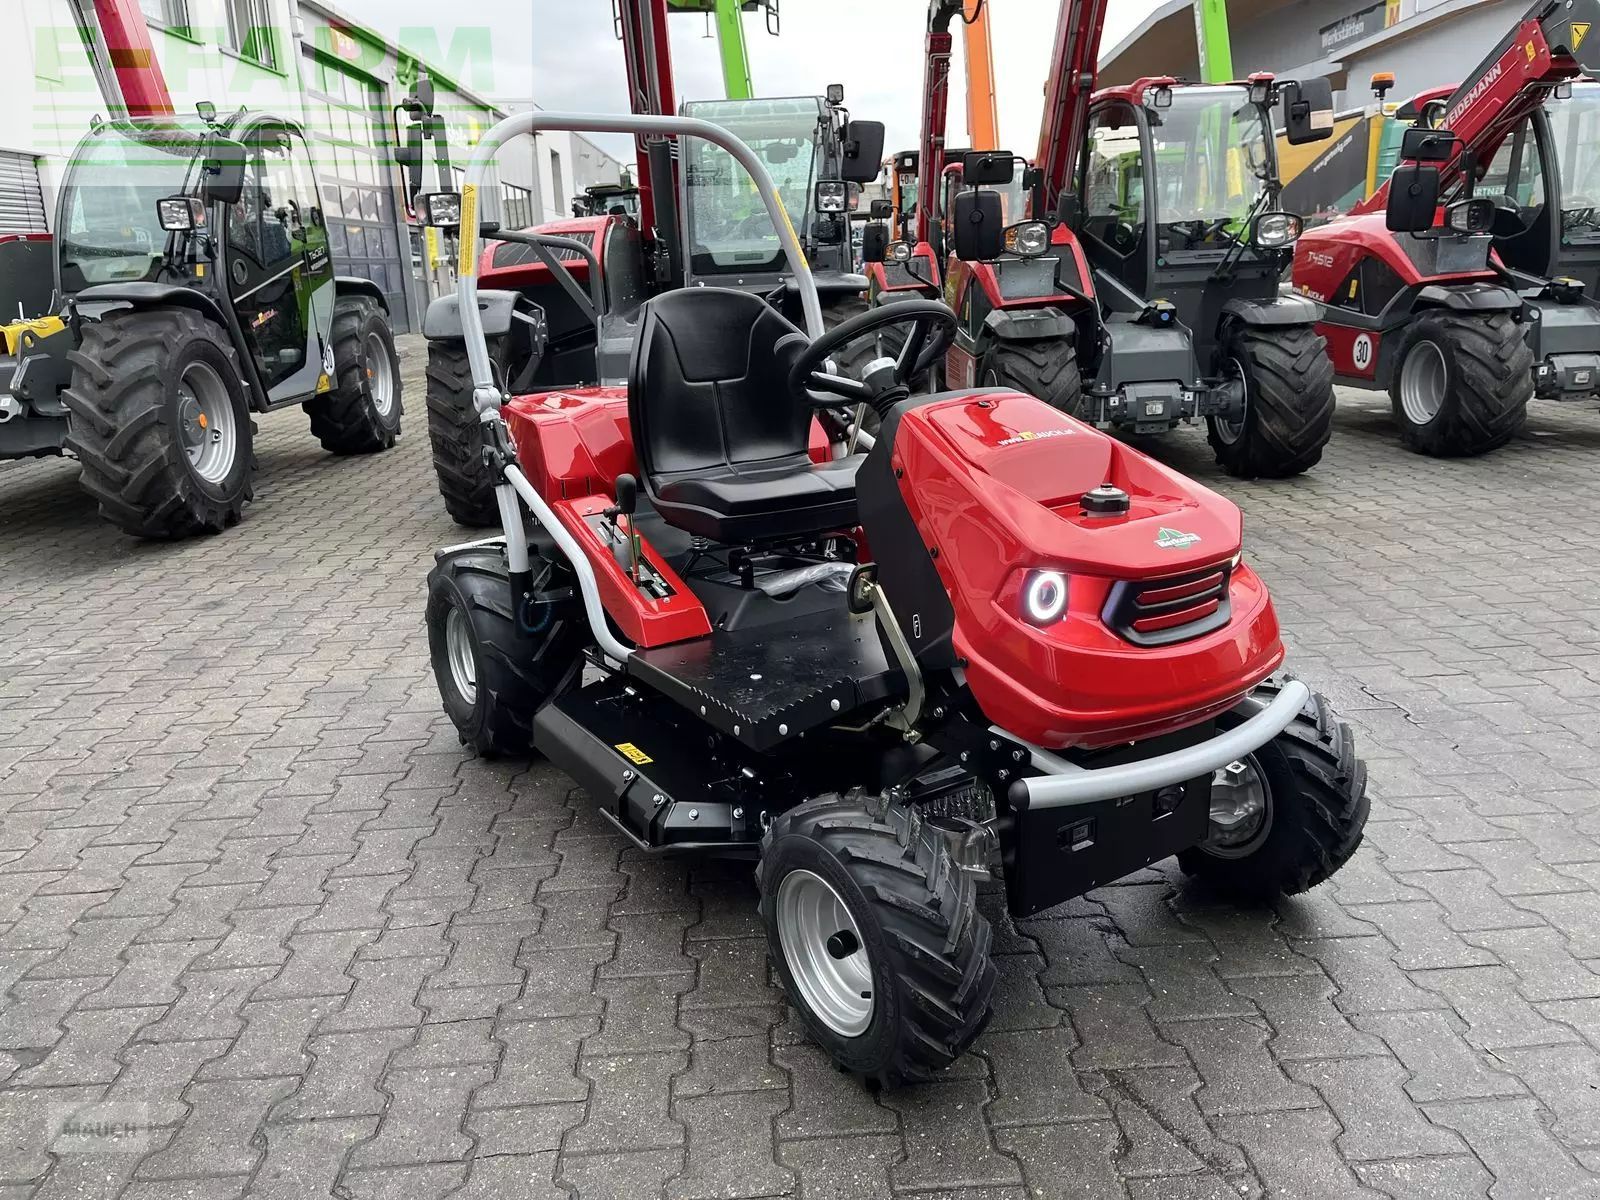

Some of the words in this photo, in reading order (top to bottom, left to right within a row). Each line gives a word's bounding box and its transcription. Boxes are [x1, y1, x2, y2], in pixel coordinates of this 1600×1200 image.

[1321, 21, 1365, 48] Werkstätten
[1308, 251, 1334, 268] T4512
[1356, 340, 1369, 363] 30
